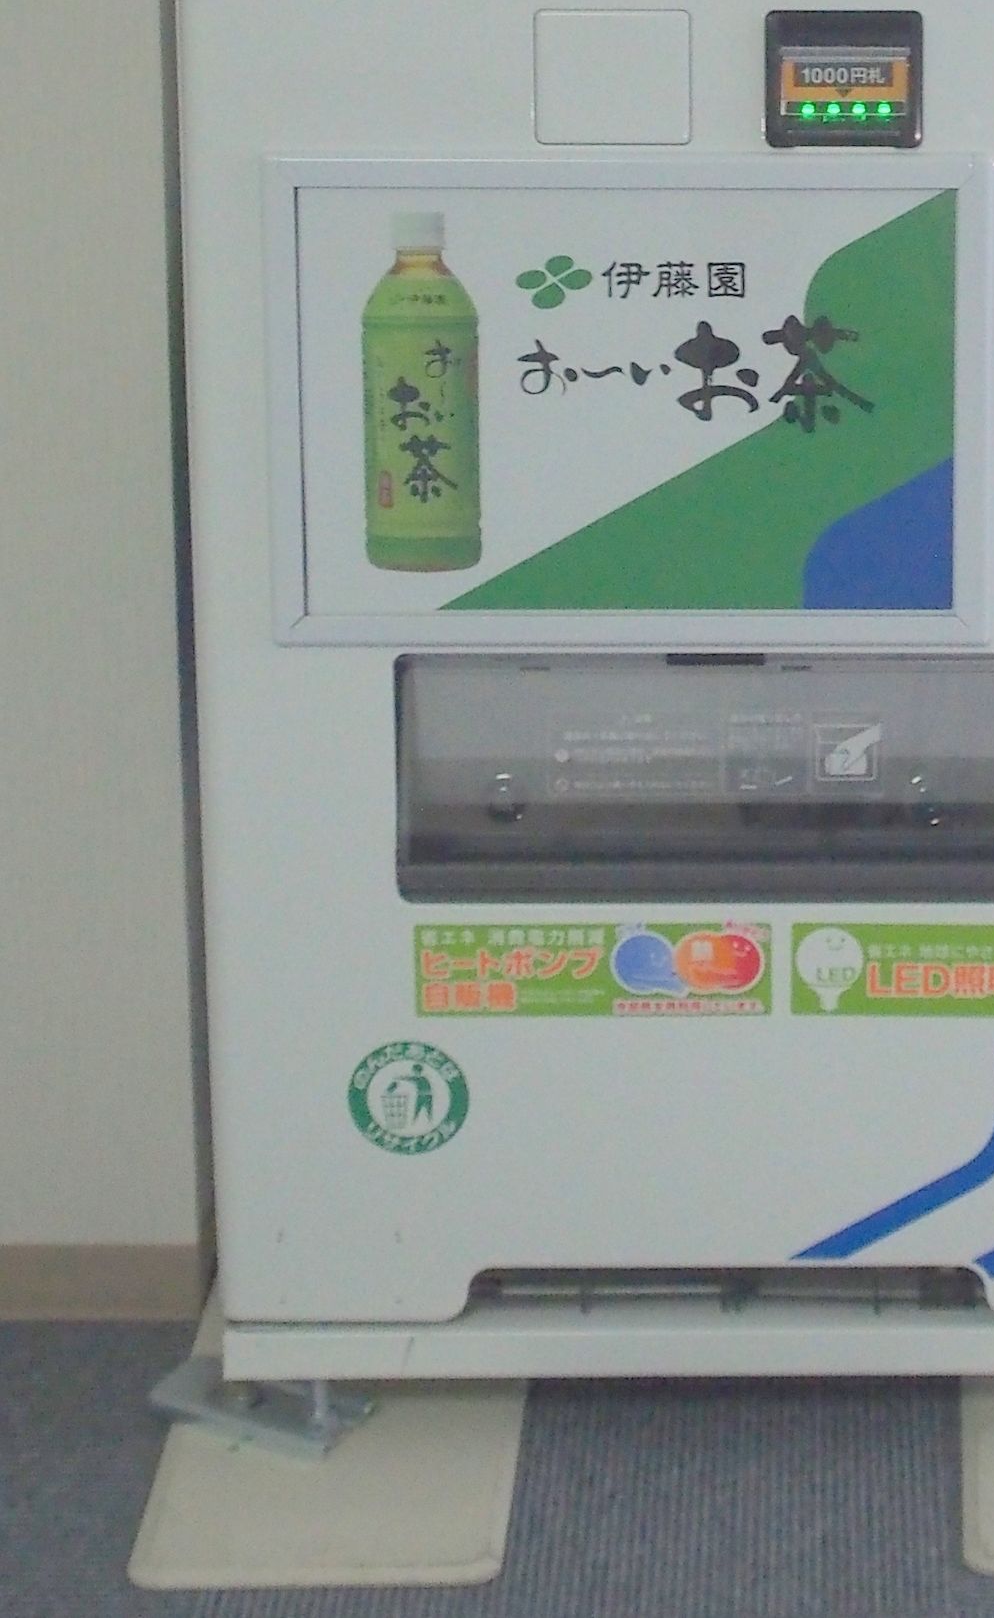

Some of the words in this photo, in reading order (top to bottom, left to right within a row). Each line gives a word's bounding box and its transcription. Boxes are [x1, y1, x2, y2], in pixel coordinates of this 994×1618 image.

[801, 67, 886, 84] 1000円札
[602, 261, 746, 299] 伊藤園
[421, 948, 601, 979] ヒートポンプ
